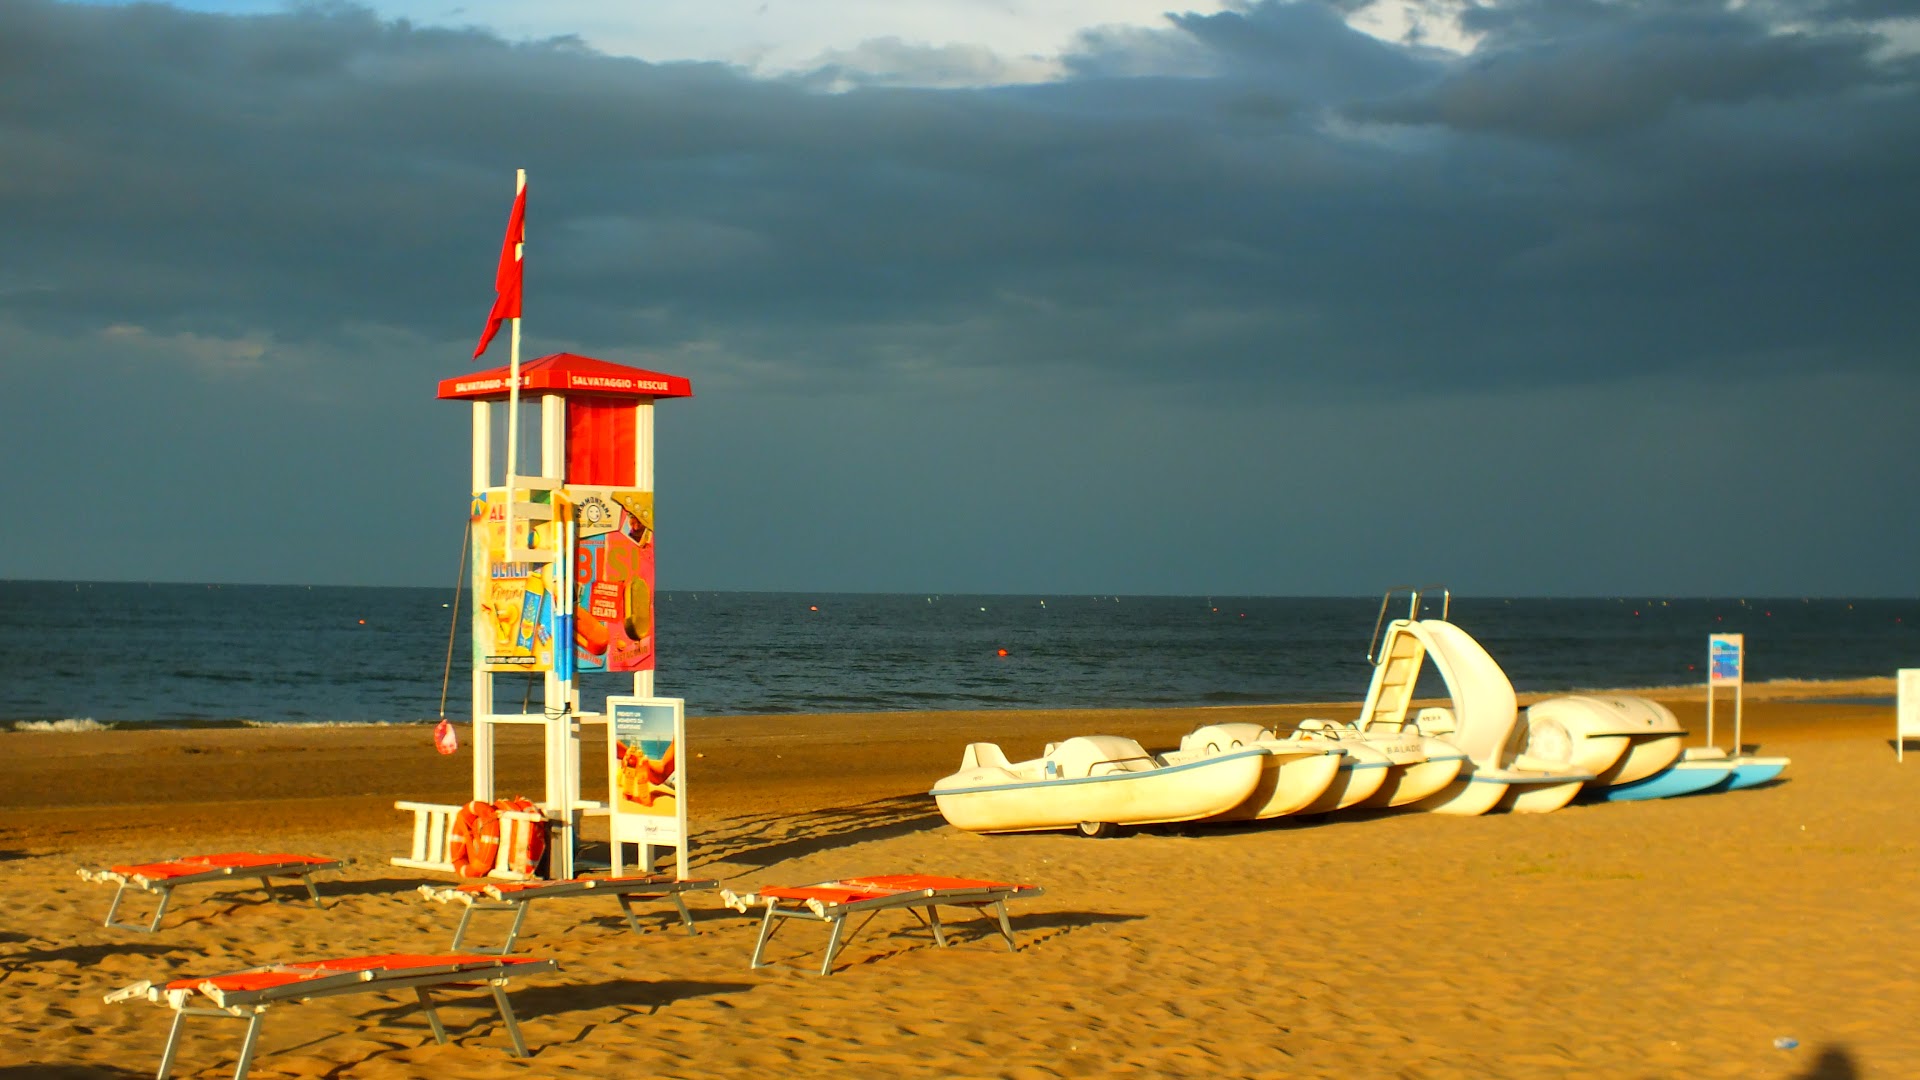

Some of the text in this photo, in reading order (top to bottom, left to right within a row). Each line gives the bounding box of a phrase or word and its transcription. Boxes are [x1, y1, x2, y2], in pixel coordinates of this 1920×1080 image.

[455, 379, 501, 393] SALVATAGGIO
[572, 376, 632, 389] SALVATAGGIO
[637, 380, 669, 391] RESCUE
[592, 606, 618, 619] GELATO
